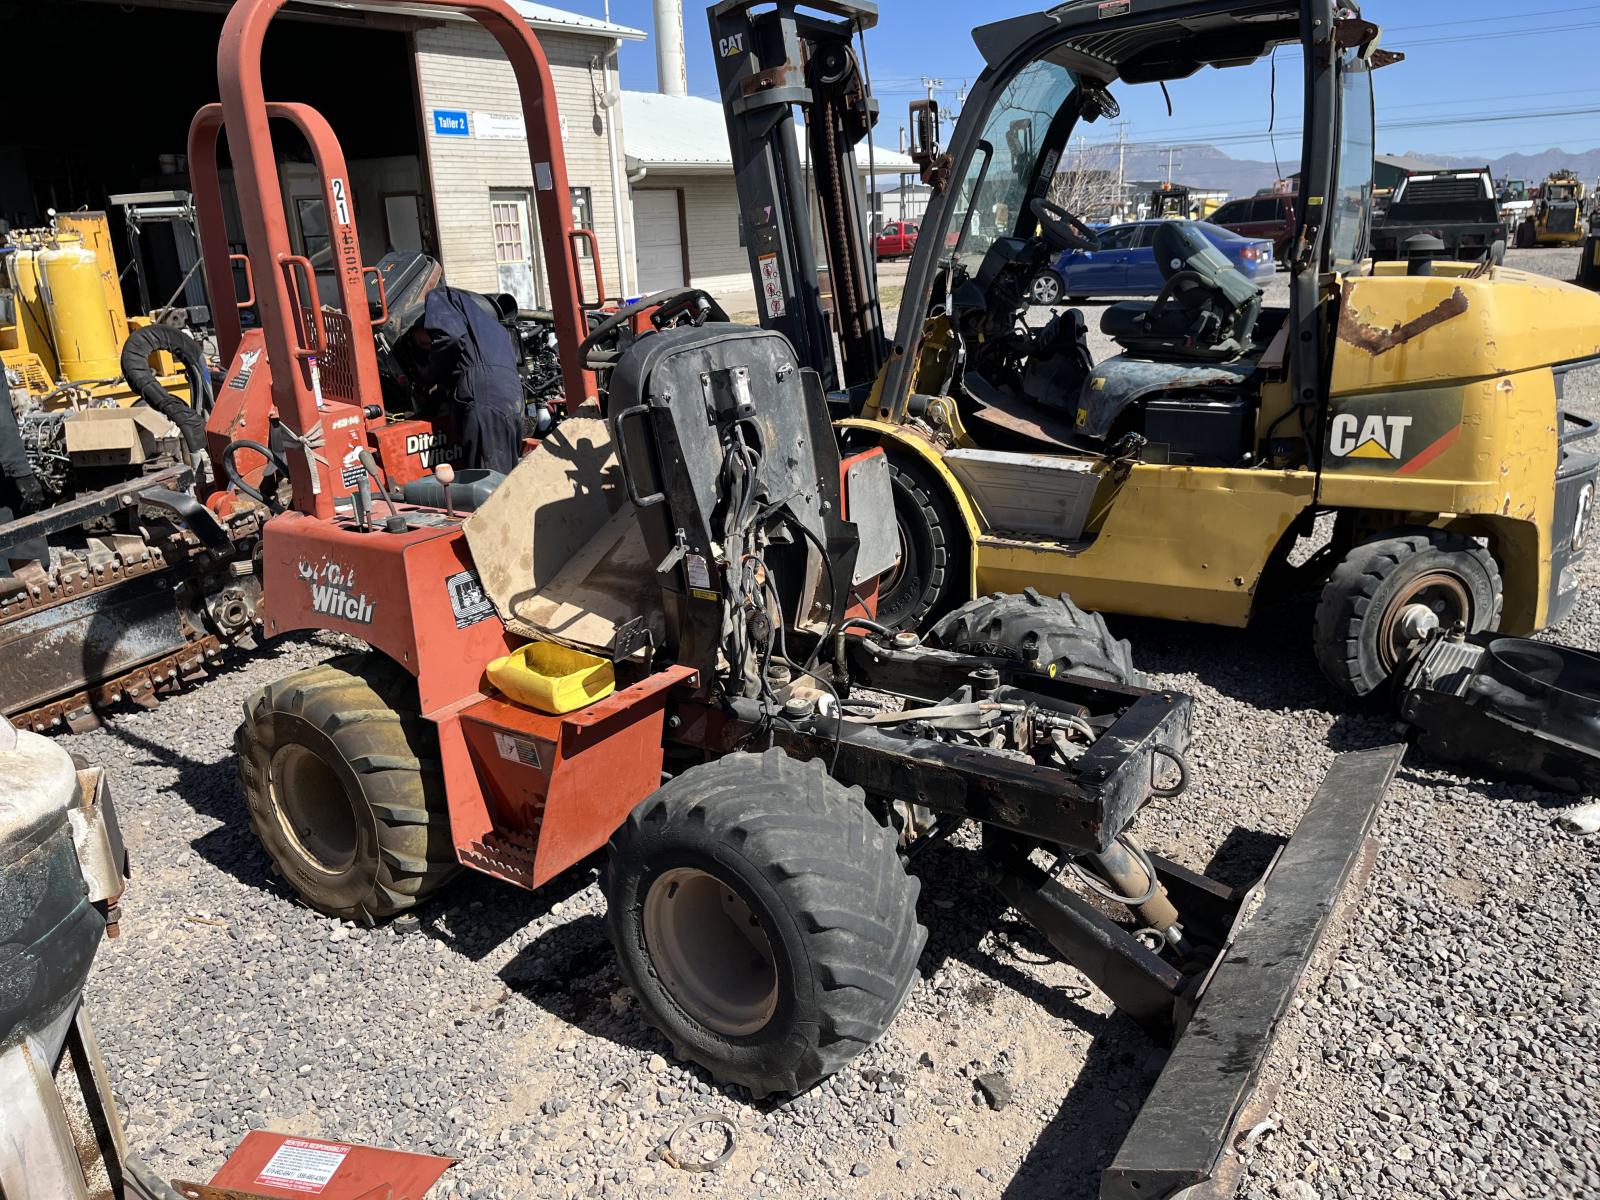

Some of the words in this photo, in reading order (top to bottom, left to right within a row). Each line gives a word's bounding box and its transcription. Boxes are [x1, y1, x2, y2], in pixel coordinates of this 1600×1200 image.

[719, 33, 743, 57] CAT
[438, 117, 459, 129] Taller
[460, 118, 465, 129] 2
[406, 430, 448, 455] Ditch
[1330, 413, 1413, 460] CAT
[419, 444, 463, 468] Witch
[312, 583, 375, 622] Witch
[309, 1142, 349, 1154] RESPONSIBILITY
